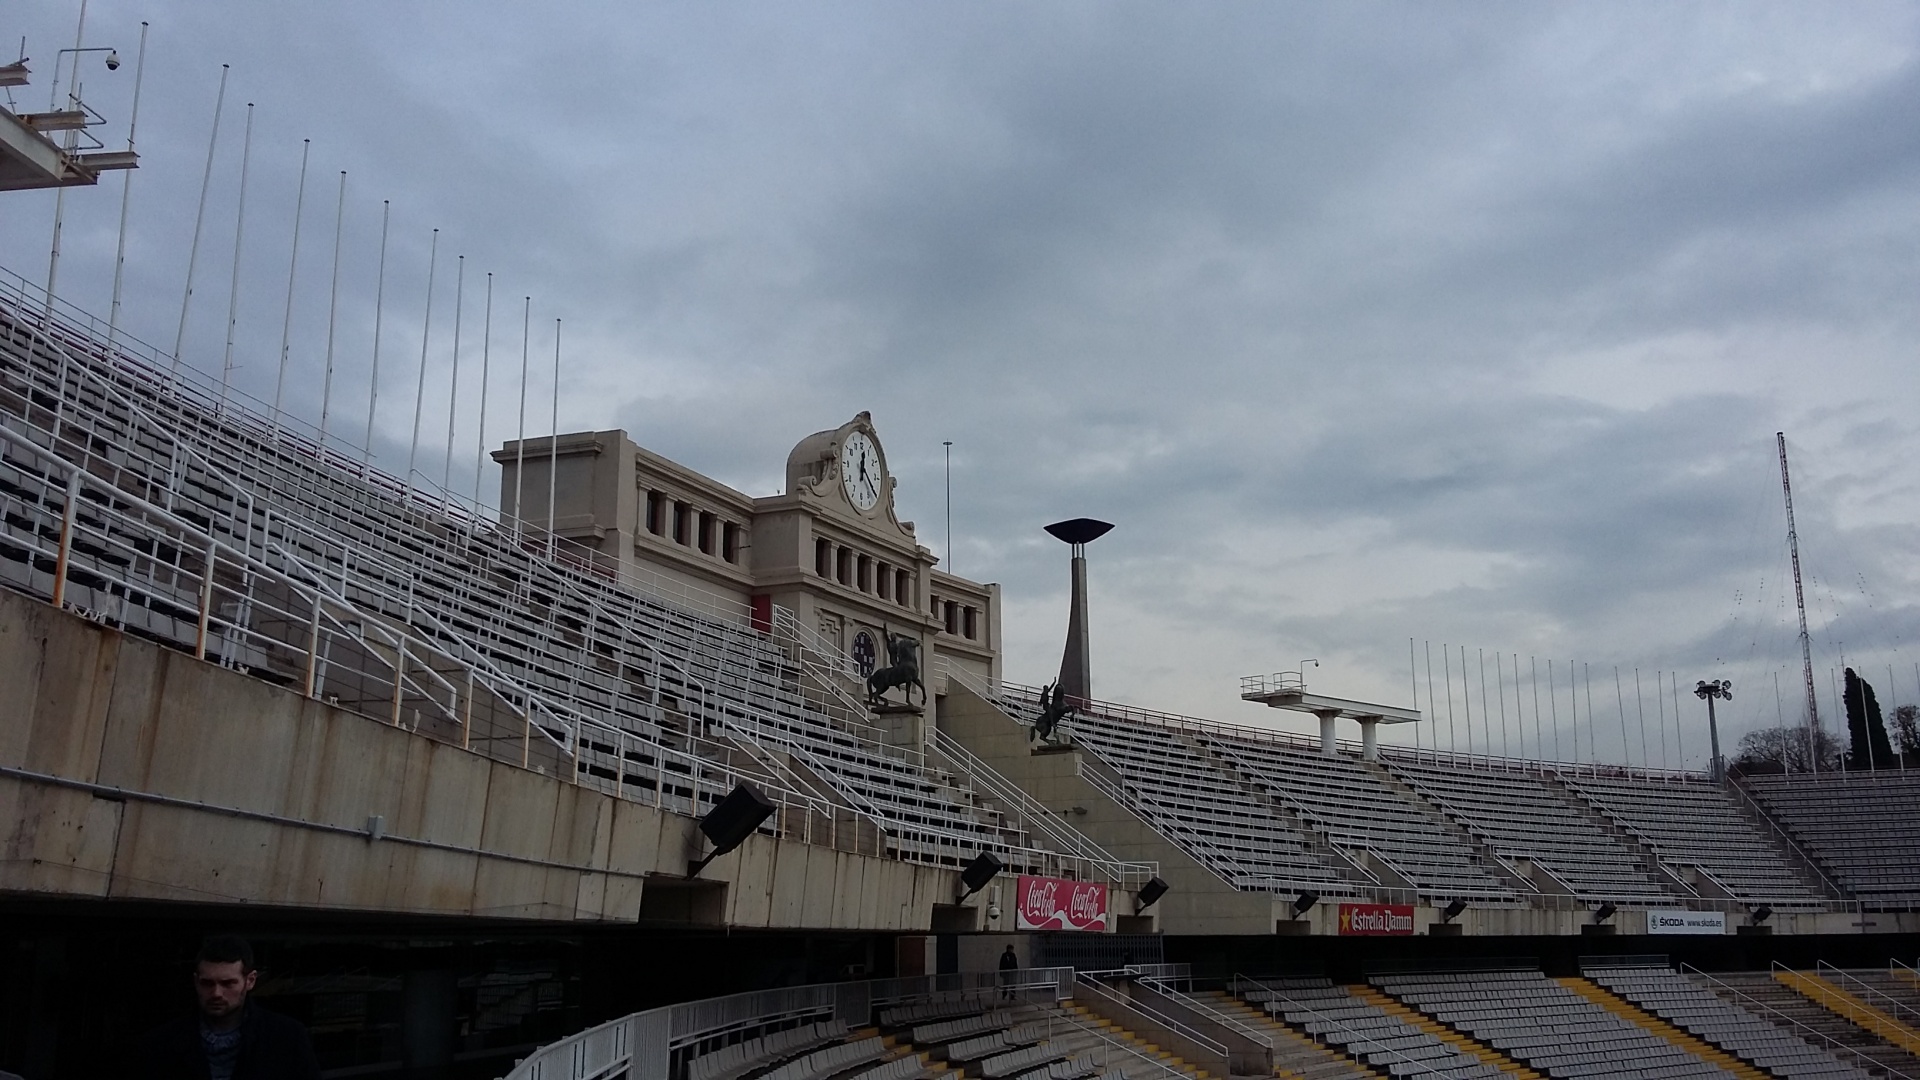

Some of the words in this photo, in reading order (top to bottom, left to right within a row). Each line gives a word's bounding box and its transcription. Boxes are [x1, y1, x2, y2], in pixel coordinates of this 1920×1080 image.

[1351, 907, 1384, 932] Estrella
[1384, 909, 1412, 932] Damm
[1660, 917, 1684, 927] ŠKODA
[1686, 918, 1722, 927] www.skoda.es
